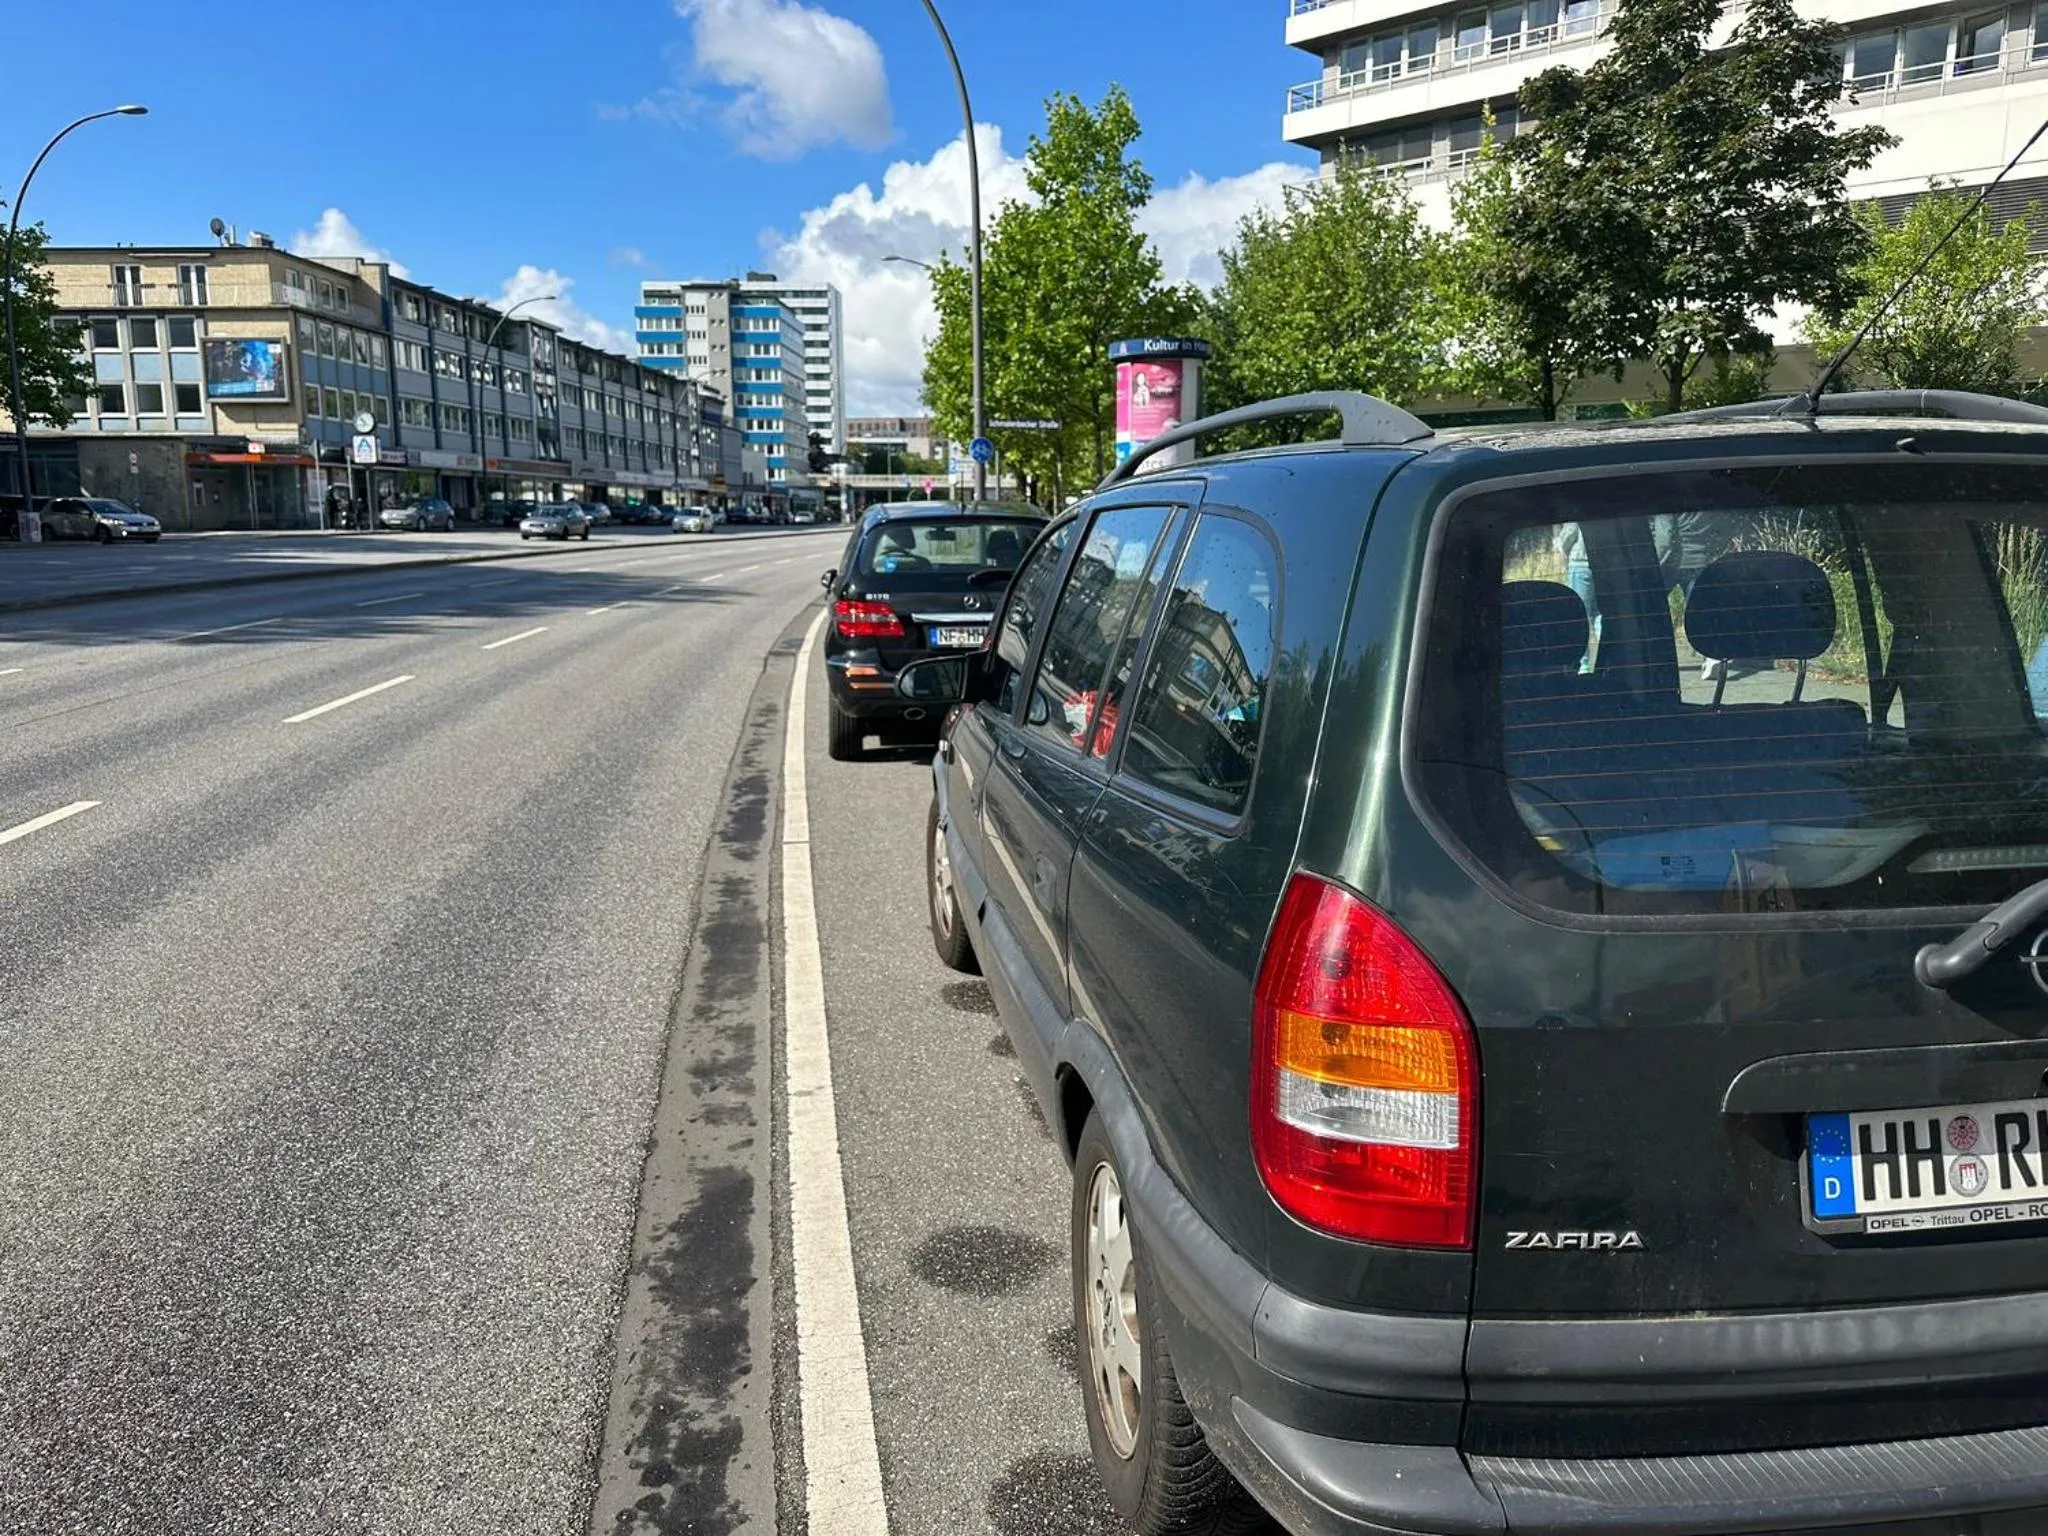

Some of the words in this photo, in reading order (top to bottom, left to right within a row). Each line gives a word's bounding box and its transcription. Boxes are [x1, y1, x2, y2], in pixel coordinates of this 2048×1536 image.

[1144, 340, 1179, 351] Kultur
[1182, 340, 1192, 350] in
[1824, 1177, 1841, 1199] D
[1858, 1118, 1947, 1201] HH
[1870, 1218, 1910, 1230] OPEL
[1930, 1214, 1965, 1226] Trittau
[1969, 1207, 2014, 1223] OPEL
[1505, 1231, 1644, 1249] ZAFIRA
